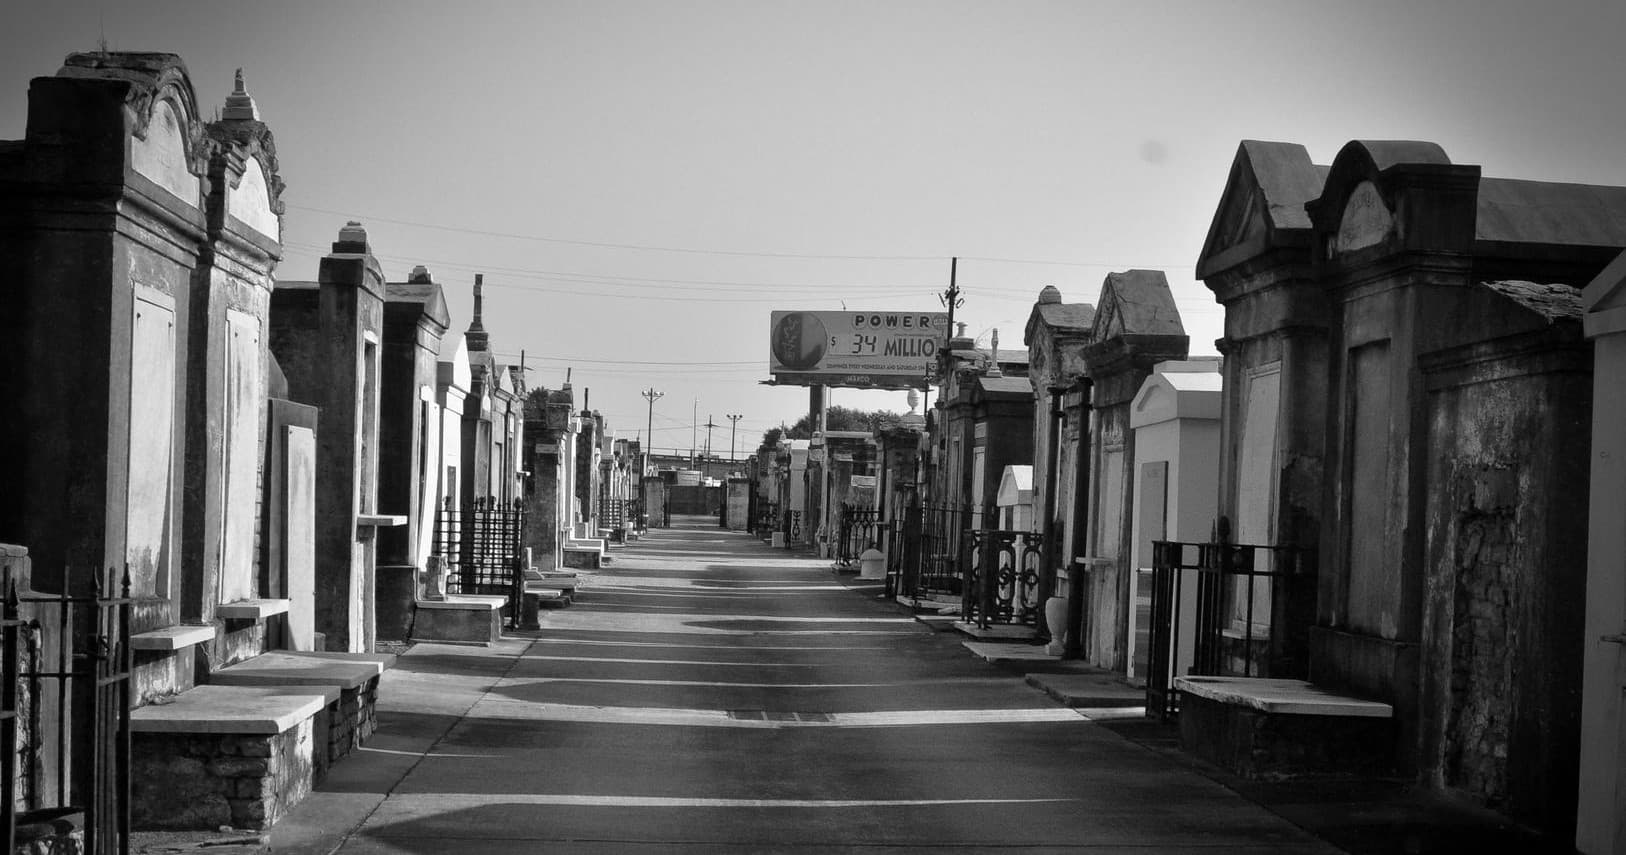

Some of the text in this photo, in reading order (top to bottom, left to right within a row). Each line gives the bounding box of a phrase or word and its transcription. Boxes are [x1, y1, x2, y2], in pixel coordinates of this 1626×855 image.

[855, 315, 930, 328] POWER
[831, 334, 935, 357] $ 34 MILLIO
